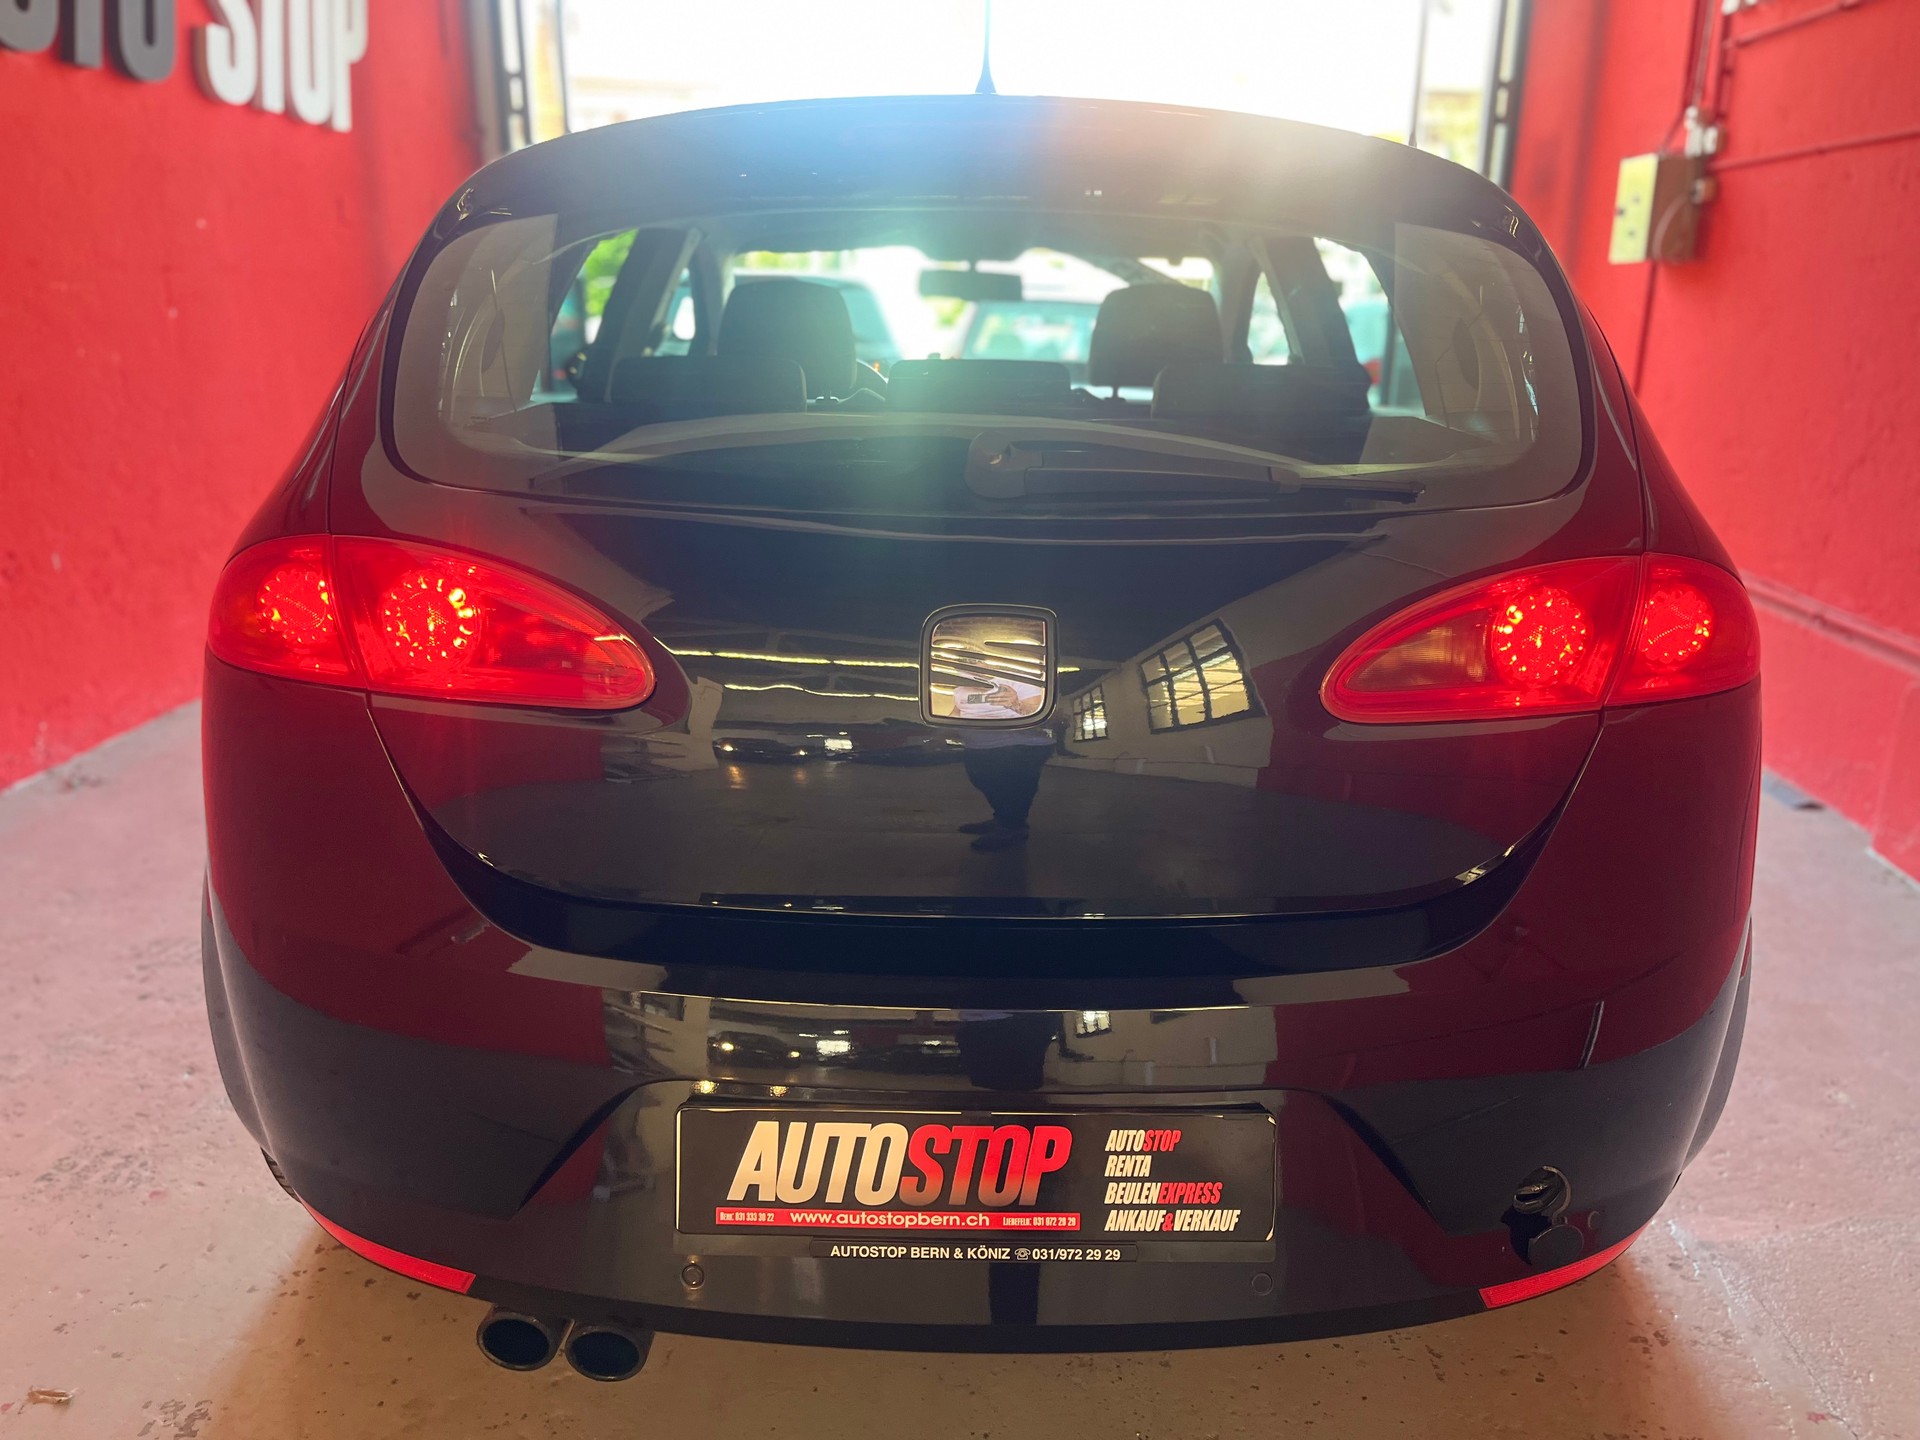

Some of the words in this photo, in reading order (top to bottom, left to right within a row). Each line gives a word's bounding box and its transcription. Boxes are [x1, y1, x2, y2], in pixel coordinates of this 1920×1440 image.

[1104, 1129, 1182, 1152] AUTOSTOP
[726, 1120, 1073, 1207] AUTOSTOP
[1104, 1155, 1152, 1177] RENTA
[1104, 1182, 1223, 1205] BEULENEXPRESS
[735, 1211, 746, 1222] 031
[766, 1212, 775, 1222] 22
[790, 1211, 990, 1228] www.autostopbern.ch
[1033, 1216, 1044, 1226] 031
[1045, 1216, 1057, 1226] 972
[1104, 1209, 1241, 1232] ANKAUF&VERKAUF
[830, 1245, 907, 1259] AUTOSTOP
[910, 1247, 950, 1259] BERN
[953, 1247, 964, 1260] &
[967, 1245, 1011, 1260] KÖNIZ
[1032, 1248, 1083, 1261] 031/972
[1086, 1249, 1102, 1261] 29
[1104, 1249, 1121, 1261] 29
